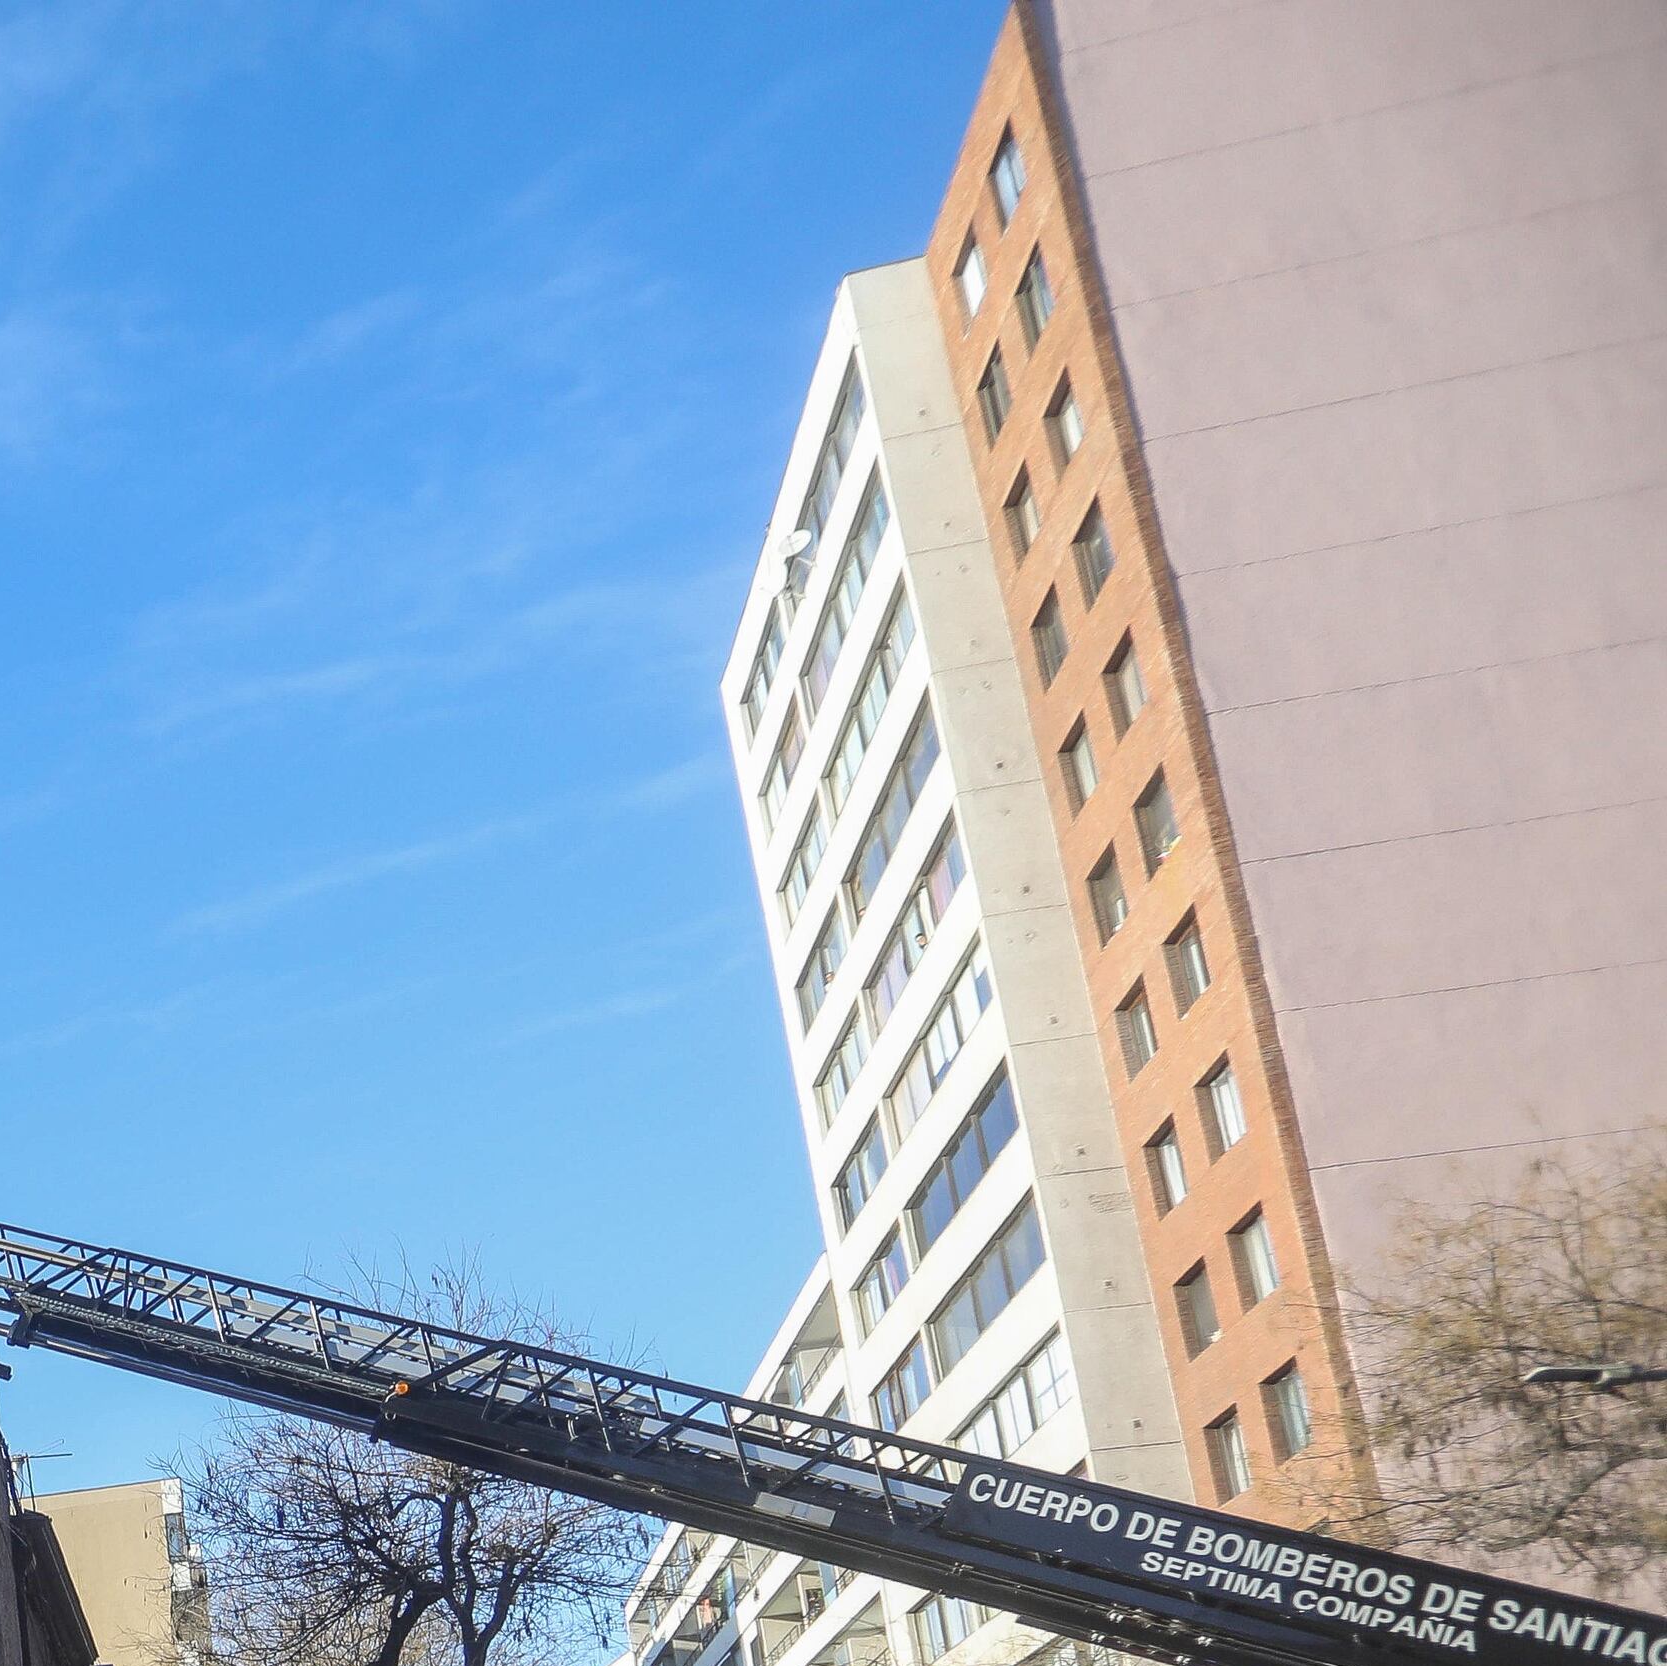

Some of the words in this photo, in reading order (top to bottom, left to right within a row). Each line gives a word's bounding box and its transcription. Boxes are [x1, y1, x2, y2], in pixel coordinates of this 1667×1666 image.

[967, 1472, 1120, 1534] CUERPO
[1125, 1510, 1183, 1551] DE
[1184, 1525, 1415, 1607] BOMBEROS
[1422, 1582, 1484, 1624] DE
[1141, 1549, 1283, 1604] SEPTIMA
[1292, 1587, 1478, 1653] COMPAÑIA
